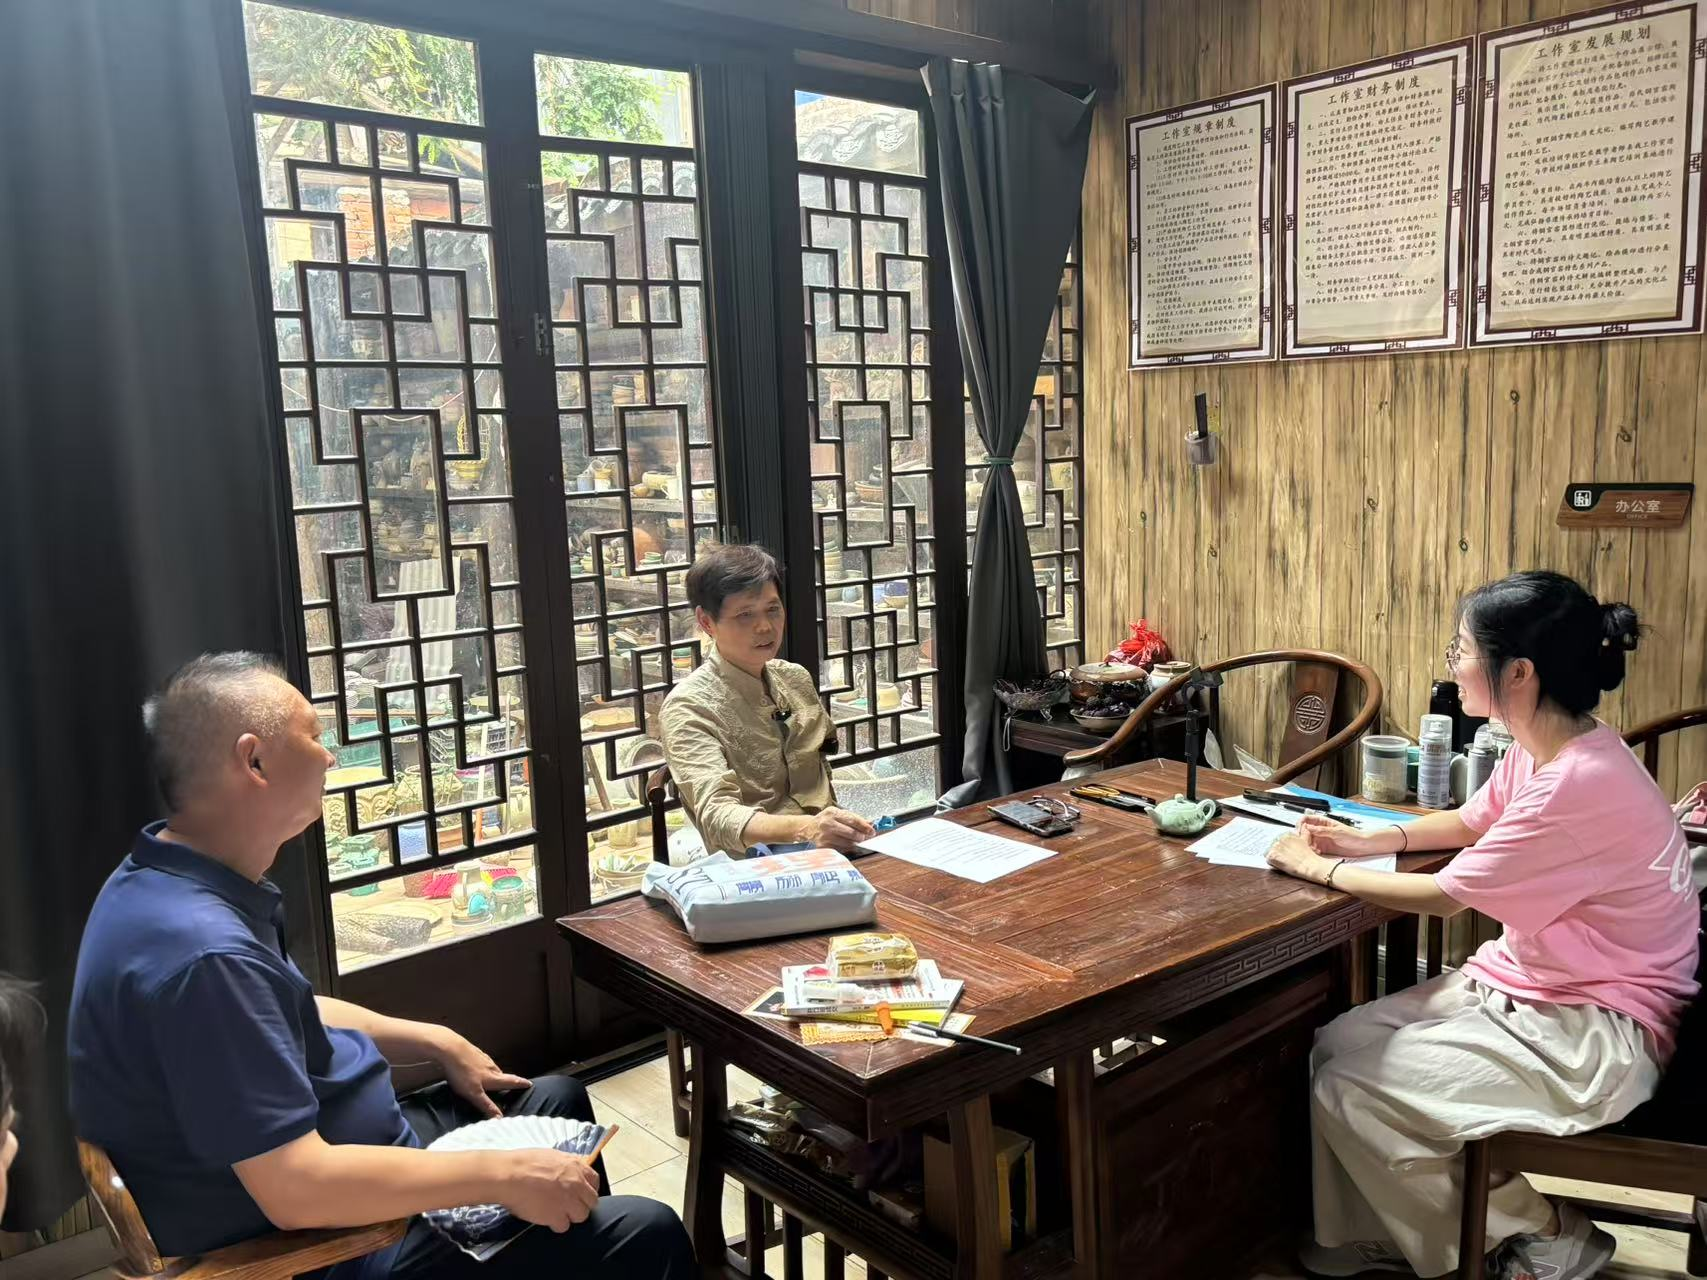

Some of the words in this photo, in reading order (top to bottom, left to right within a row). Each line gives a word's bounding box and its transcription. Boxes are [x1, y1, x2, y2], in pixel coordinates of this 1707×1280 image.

[1534, 24, 1650, 61] 工作室发展规划
[1327, 73, 1420, 107] 工作室财务制度
[1161, 115, 1236, 142] 工作室规章制度
[1615, 499, 1661, 513] 办公室
